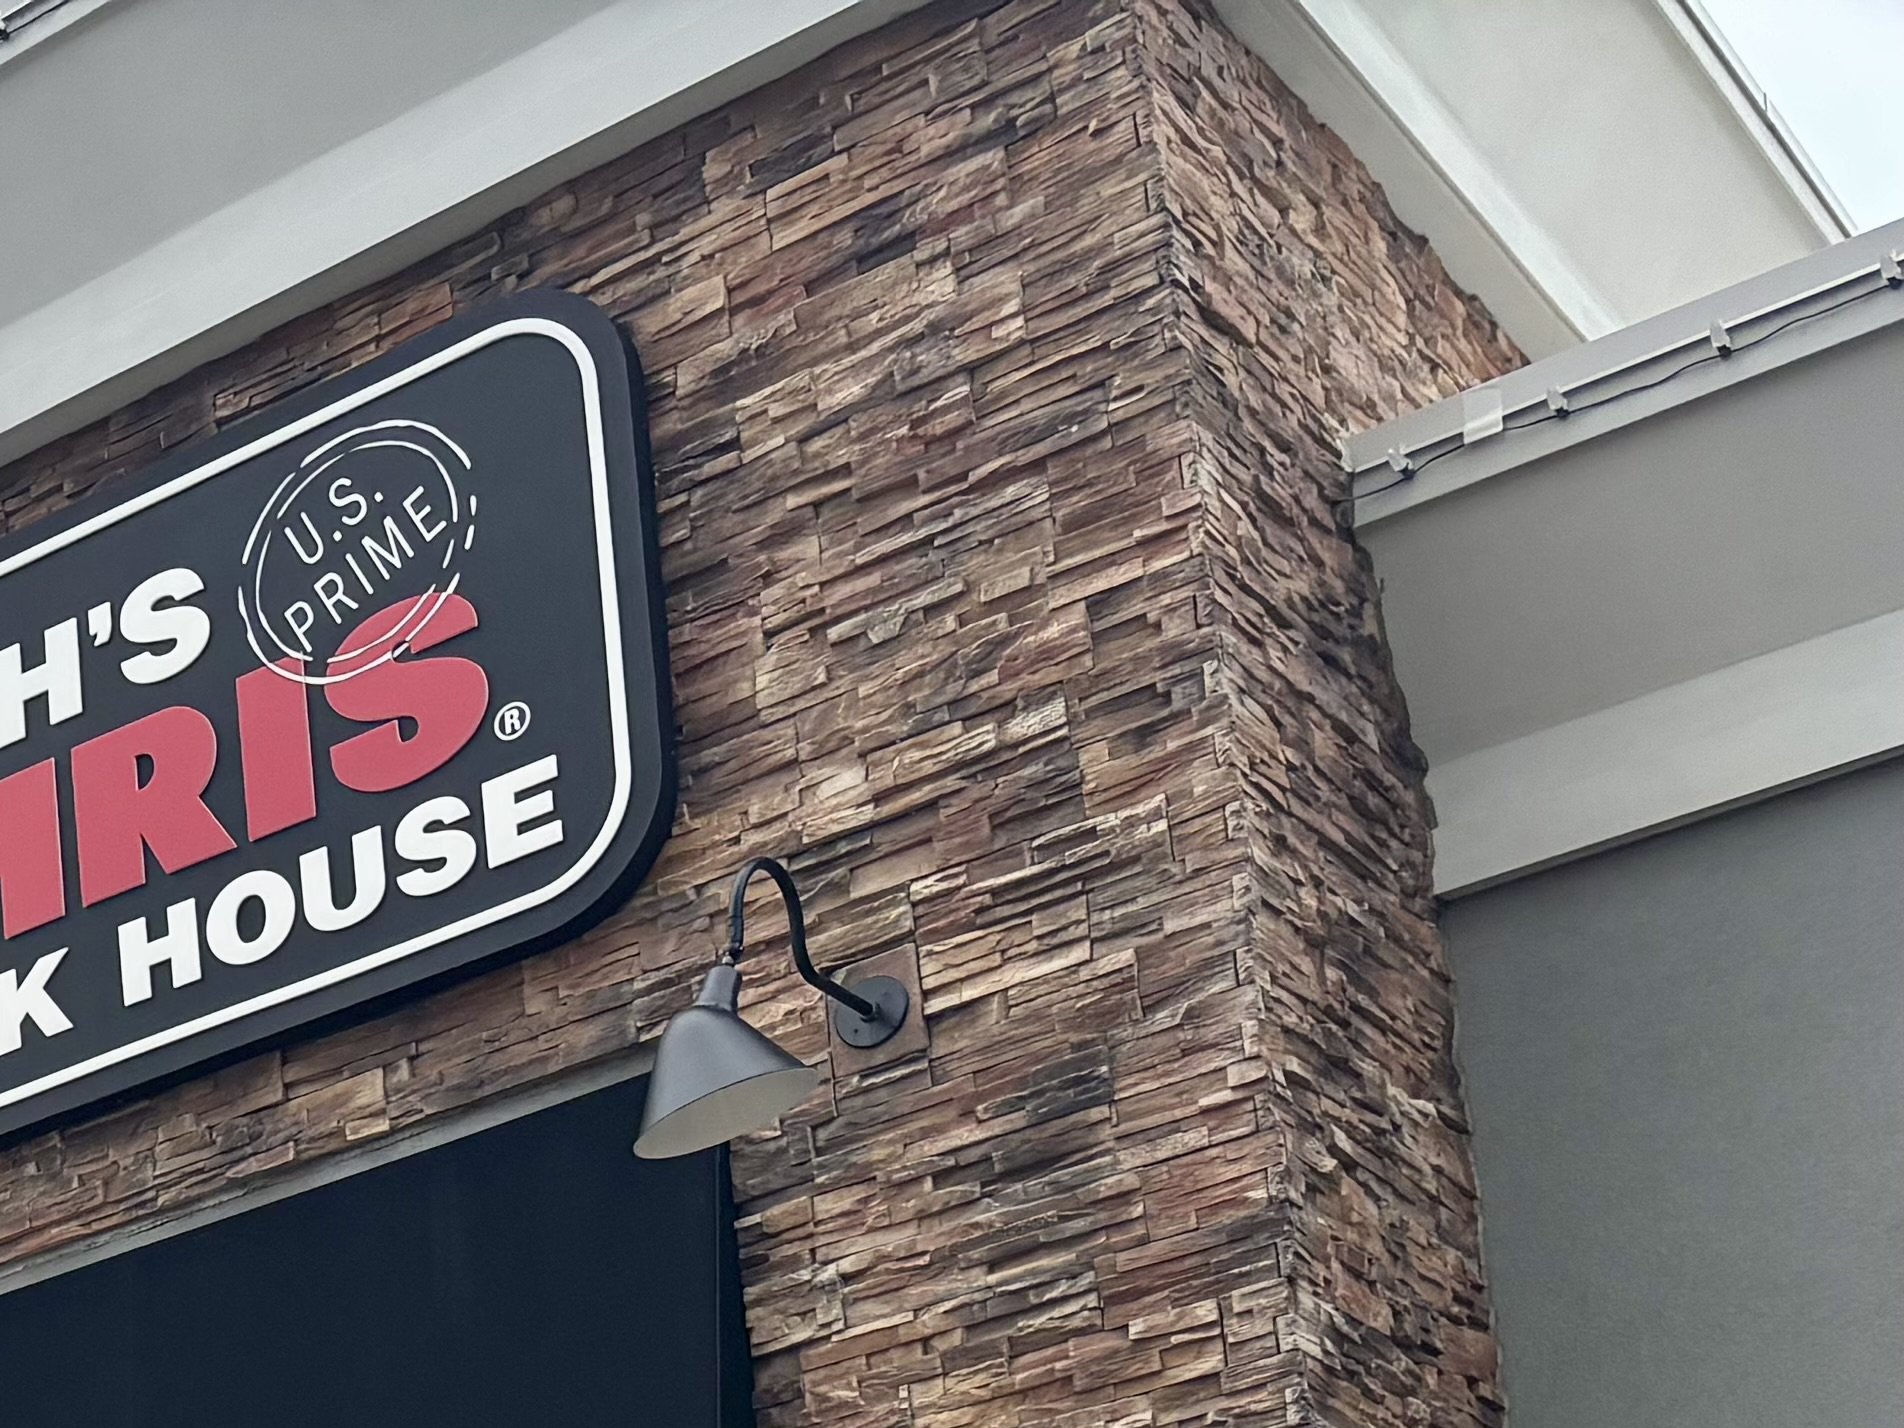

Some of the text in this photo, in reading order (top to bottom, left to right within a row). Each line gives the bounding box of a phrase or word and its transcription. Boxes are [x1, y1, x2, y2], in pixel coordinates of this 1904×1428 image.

[283, 485, 448, 653] PRIME
[284, 477, 384, 565] U.S.
[116, 755, 567, 1007] HOUSE
